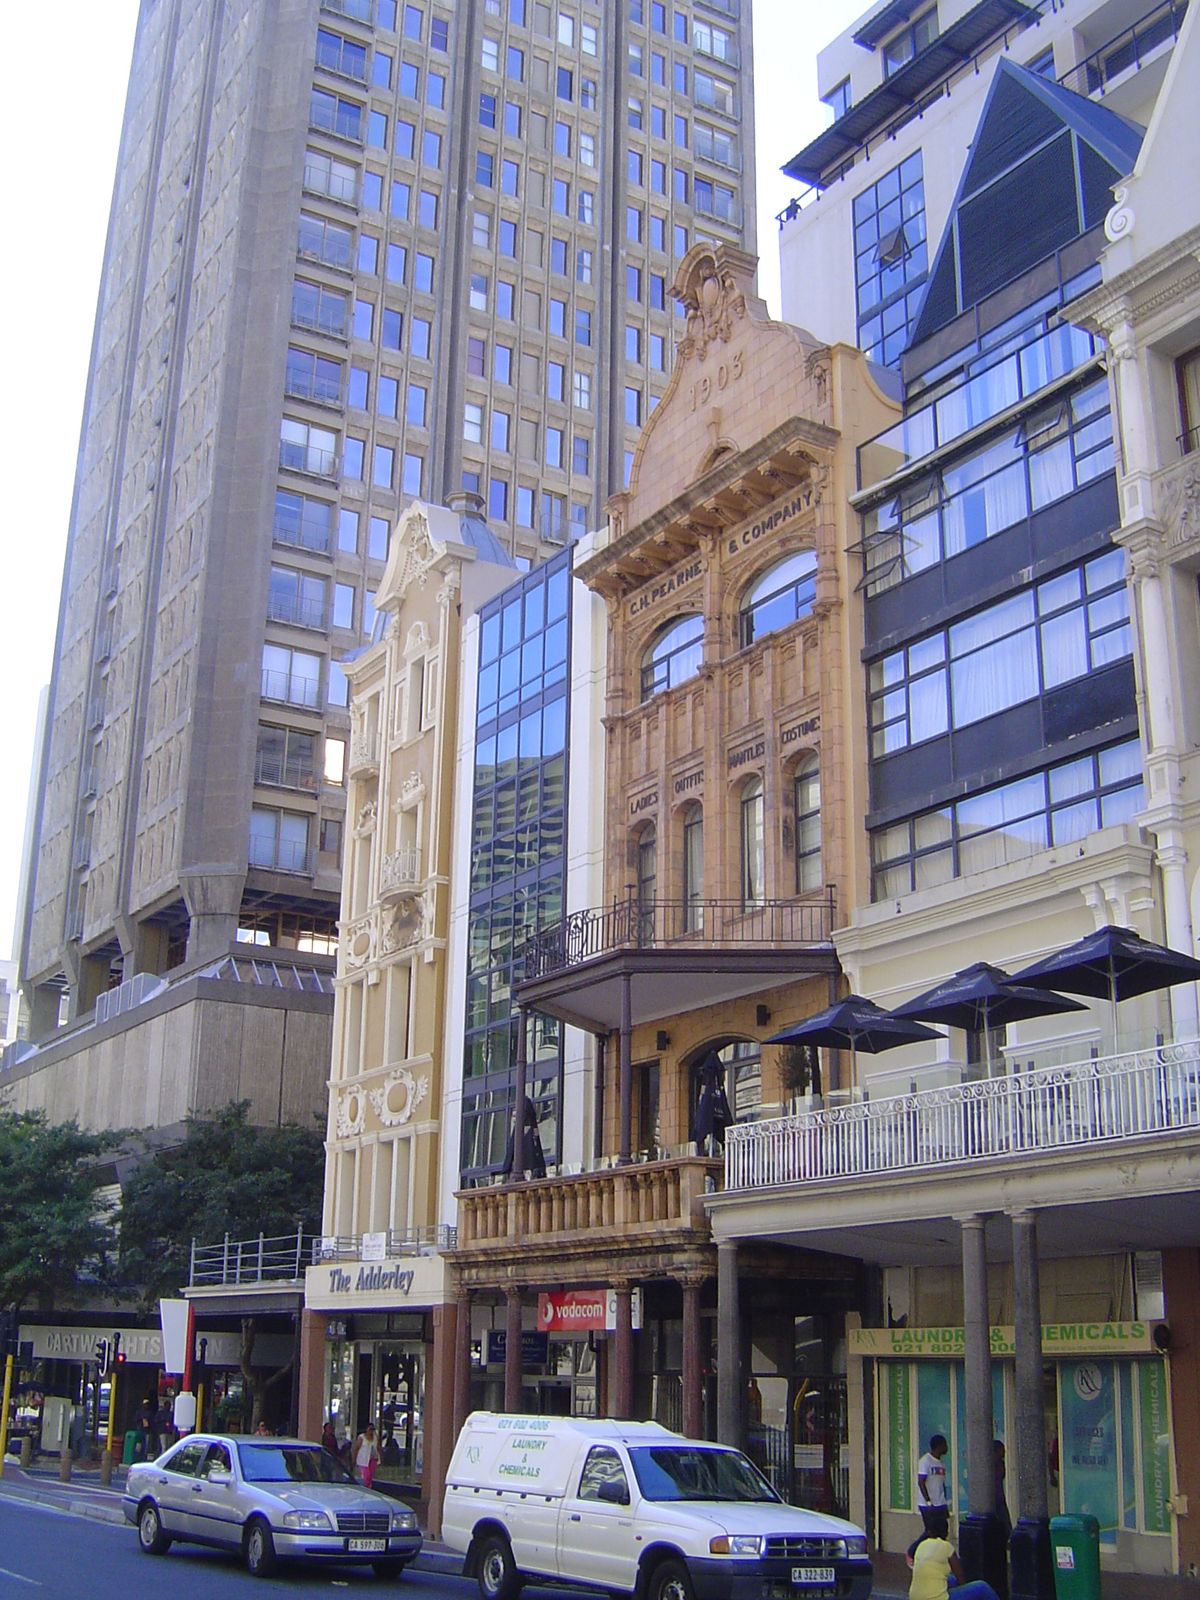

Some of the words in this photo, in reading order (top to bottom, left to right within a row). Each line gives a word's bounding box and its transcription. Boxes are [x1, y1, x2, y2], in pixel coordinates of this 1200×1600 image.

[651, 560, 703, 603] PEARNE
[728, 539, 739, 554] &
[742, 490, 813, 545] COMPANY
[727, 741, 766, 769] MANTLES
[630, 791, 660, 814] LADIES
[329, 1267, 351, 1293] The
[355, 1264, 415, 1296] Adderley
[556, 1300, 604, 1319] vodacom
[890, 1328, 966, 1343] LAUNDR
[991, 1327, 1004, 1342] &
[1041, 1323, 1146, 1341] EMICALS
[893, 1343, 922, 1353] 021
[931, 1343, 964, 1352] 802
[511, 1439, 548, 1450] LAUNDRY
[522, 1453, 528, 1463] &
[498, 1464, 541, 1477] CHEMICALS
[793, 1569, 802, 1580] CA
